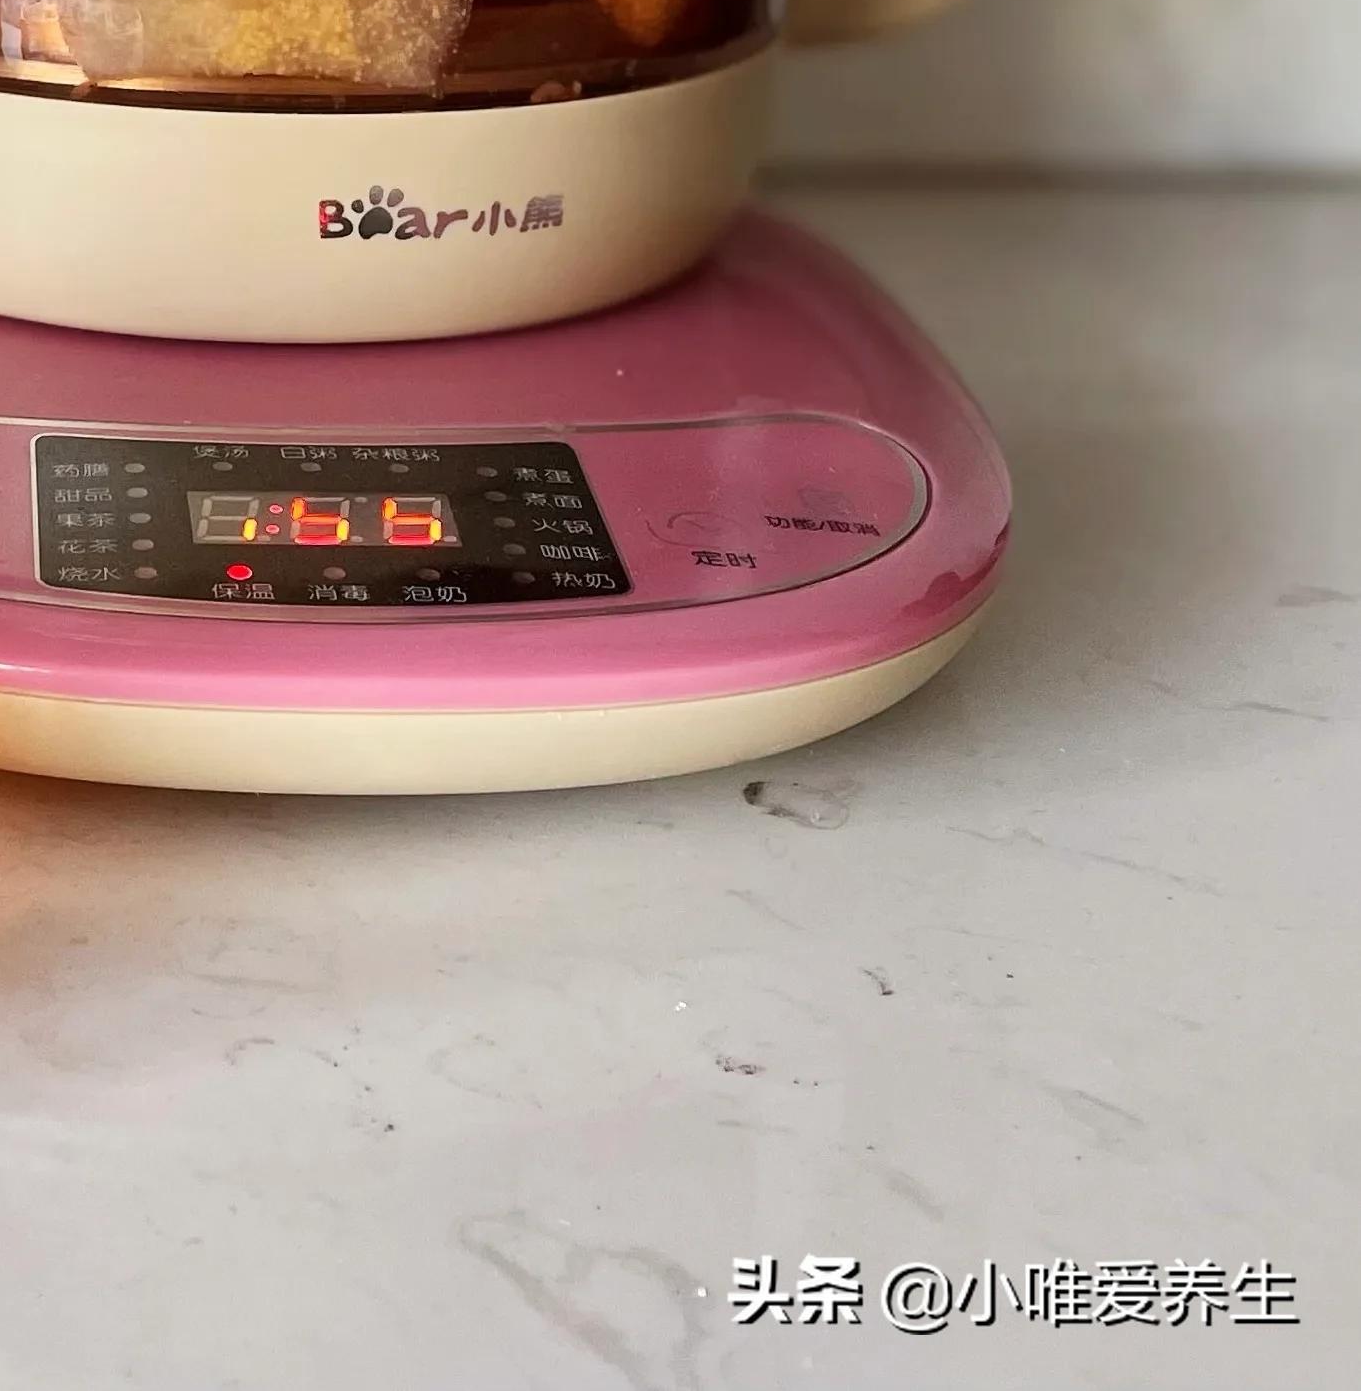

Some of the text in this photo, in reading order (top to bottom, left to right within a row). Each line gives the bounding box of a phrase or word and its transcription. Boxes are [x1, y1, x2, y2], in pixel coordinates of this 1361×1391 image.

[54, 487, 113, 504] 甜品
[55, 512, 116, 528] 果茶
[532, 518, 593, 535] 火锅
[58, 539, 119, 554] 花茶
[540, 544, 604, 561] 咖啡
[691, 550, 757, 569] 定时
[58, 566, 120, 582] 烧水
[551, 571, 616, 589] 热奶
[211, 583, 275, 600] 保温
[307, 584, 371, 602] 消毒
[402, 585, 468, 603] 泡奶
